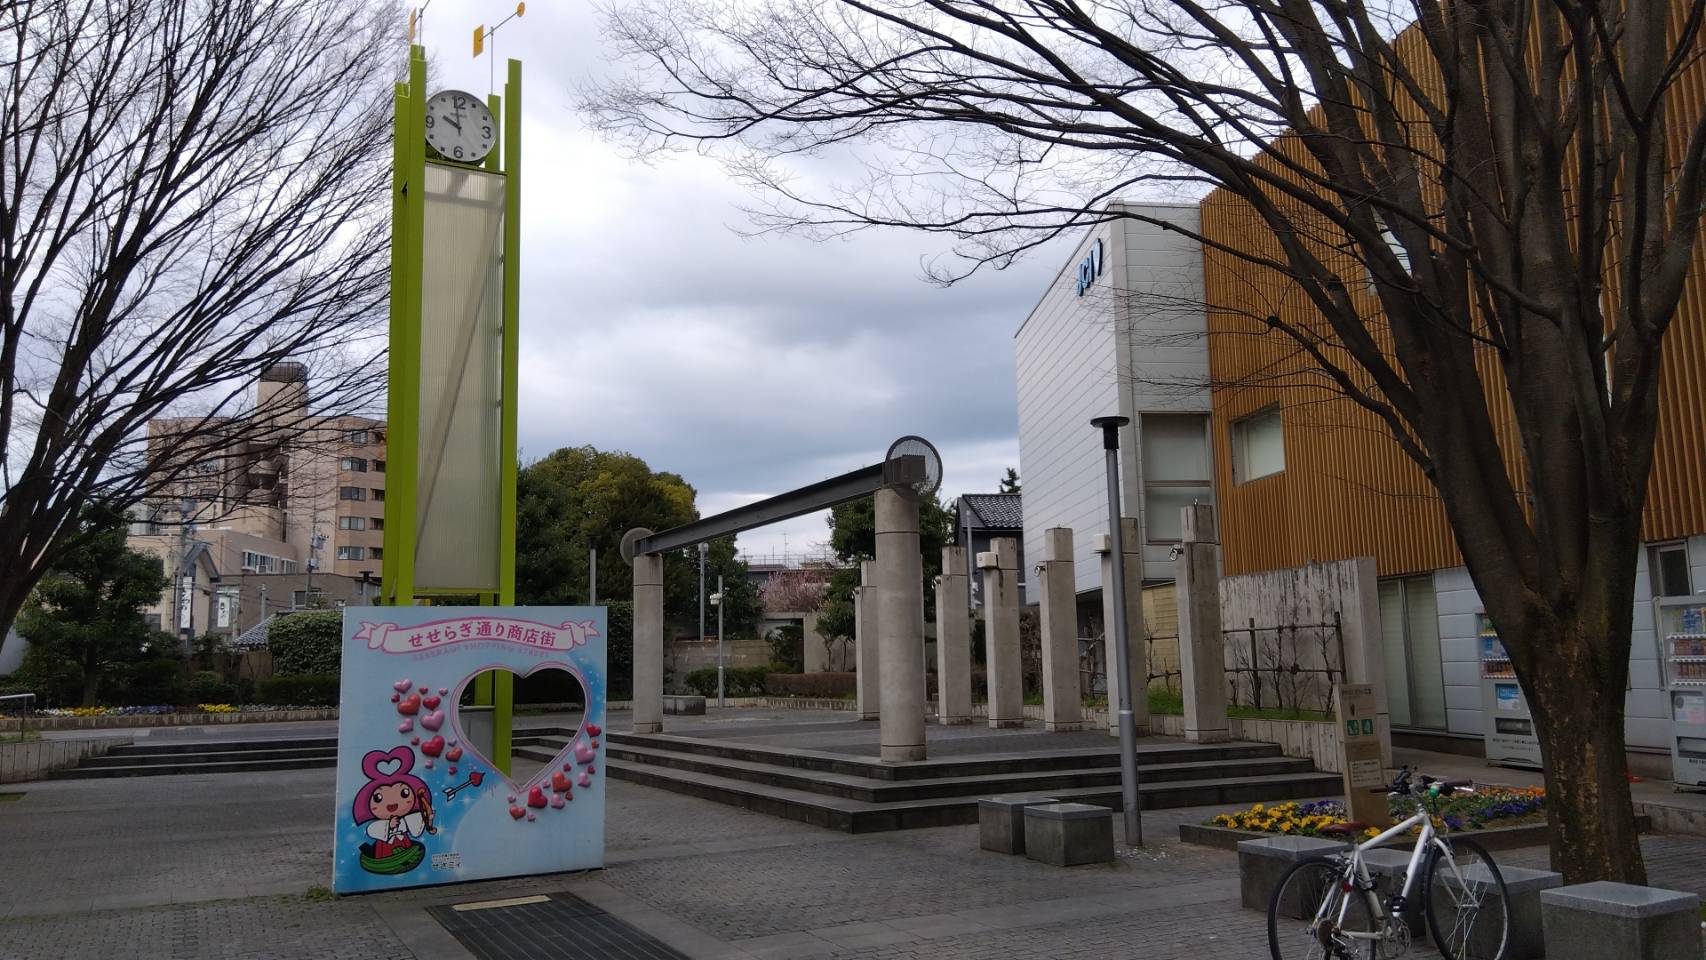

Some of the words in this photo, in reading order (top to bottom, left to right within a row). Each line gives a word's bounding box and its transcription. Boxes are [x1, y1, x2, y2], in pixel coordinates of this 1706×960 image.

[453, 96, 466, 110] 12
[425, 115, 434, 129] 9
[482, 126, 491, 139] 3
[453, 146, 463, 158] 6
[408, 621, 556, 647] せせらぎ通り商店街
